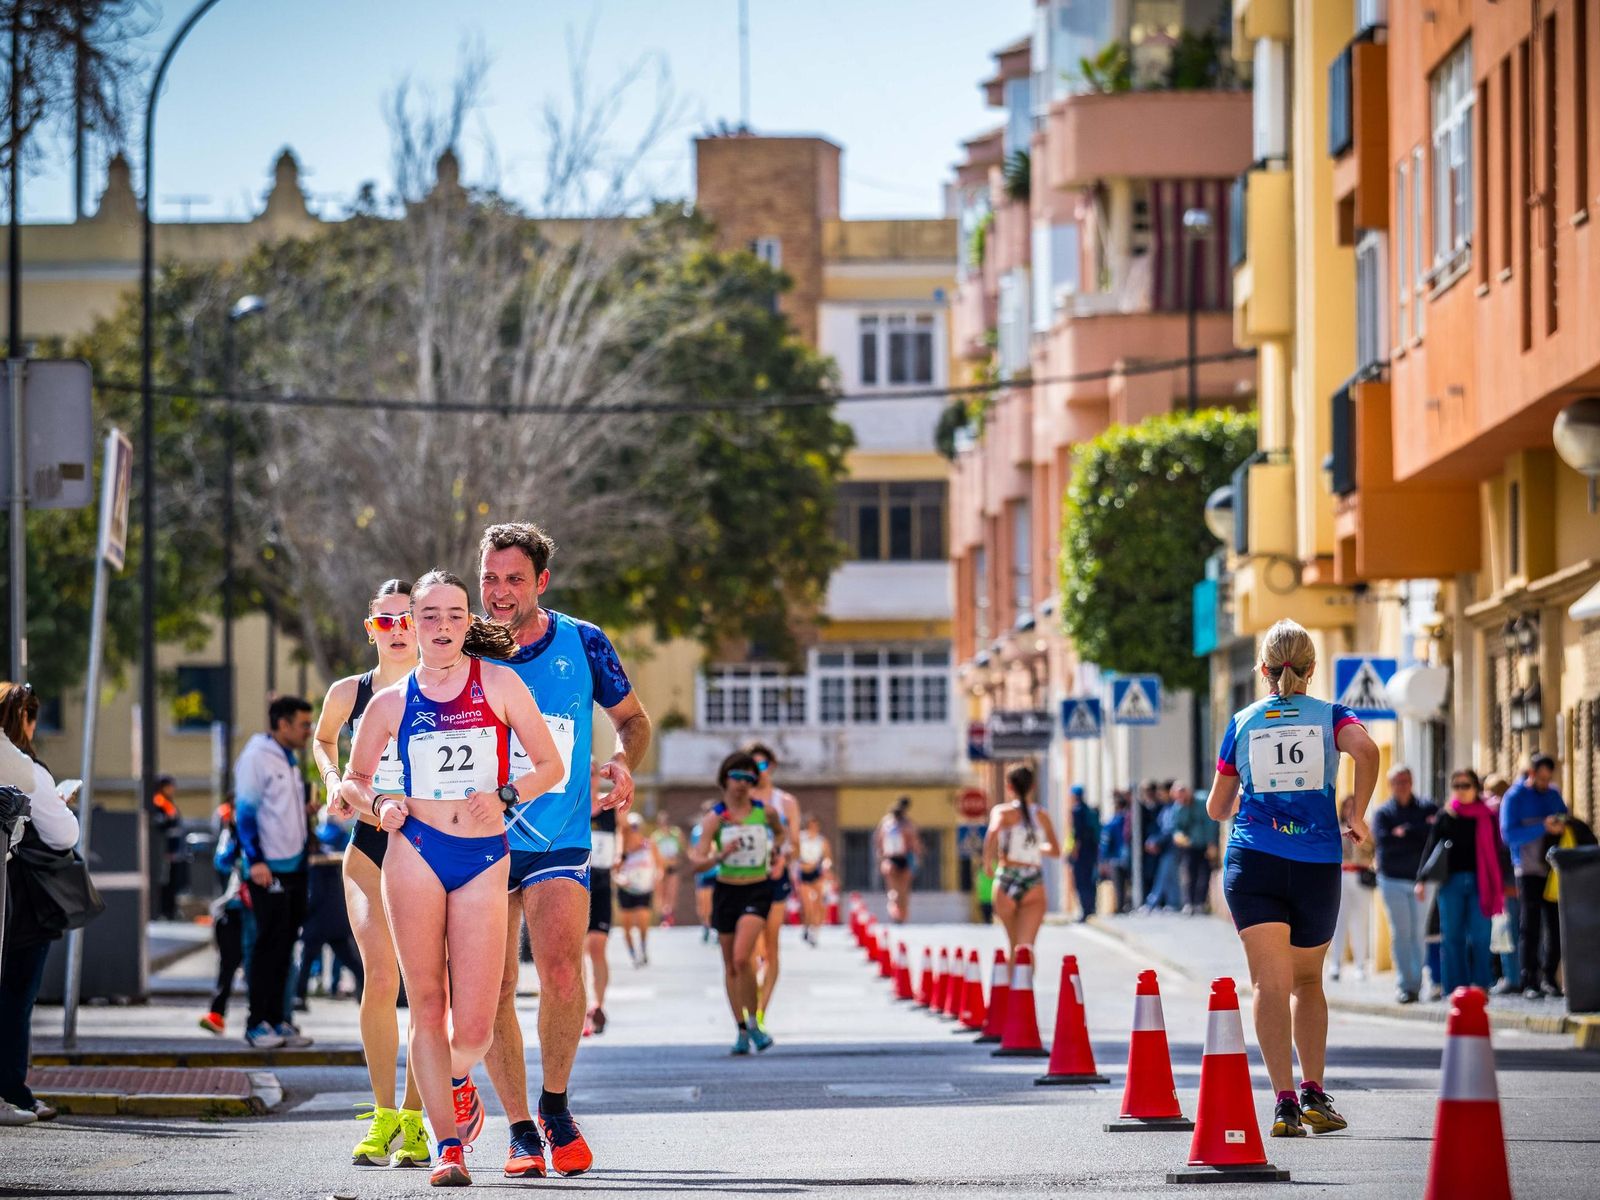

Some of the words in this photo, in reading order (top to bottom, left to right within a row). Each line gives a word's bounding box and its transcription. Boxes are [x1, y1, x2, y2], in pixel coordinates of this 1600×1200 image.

[440, 710, 482, 724] lapalma
[437, 745, 475, 772] 22
[1273, 741, 1304, 765] 16
